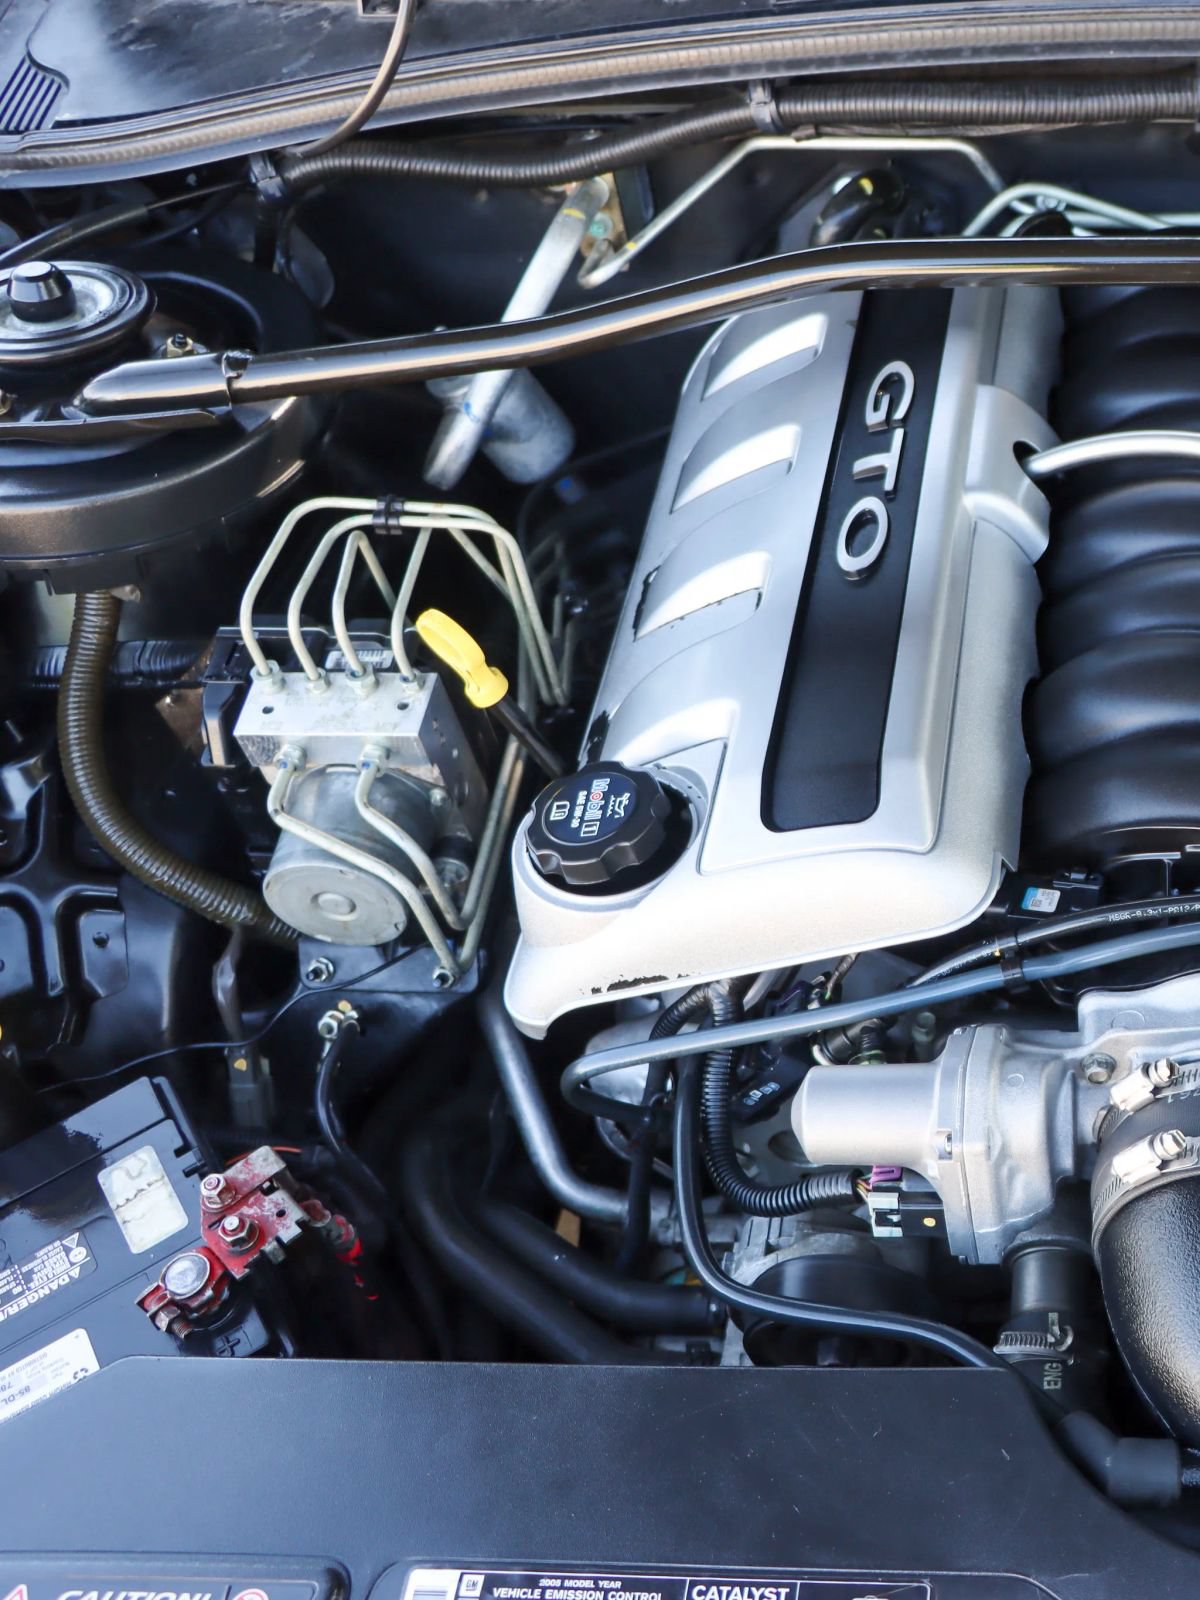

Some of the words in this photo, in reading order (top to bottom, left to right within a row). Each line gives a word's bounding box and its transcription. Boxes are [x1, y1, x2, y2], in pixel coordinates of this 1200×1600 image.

[837, 360, 915, 578] GTO
[585, 778, 610, 820] Mobil
[1043, 1362, 1062, 1389] ENG
[465, 1579, 479, 1590] GM
[564, 1579, 595, 1588] MODEL
[598, 1580, 622, 1590] YEAR
[492, 1586, 541, 1600] VEHICLE
[546, 1588, 602, 1600] EMISSION
[606, 1590, 662, 1600] CONTROL
[691, 1585, 790, 1600] CATALYST
